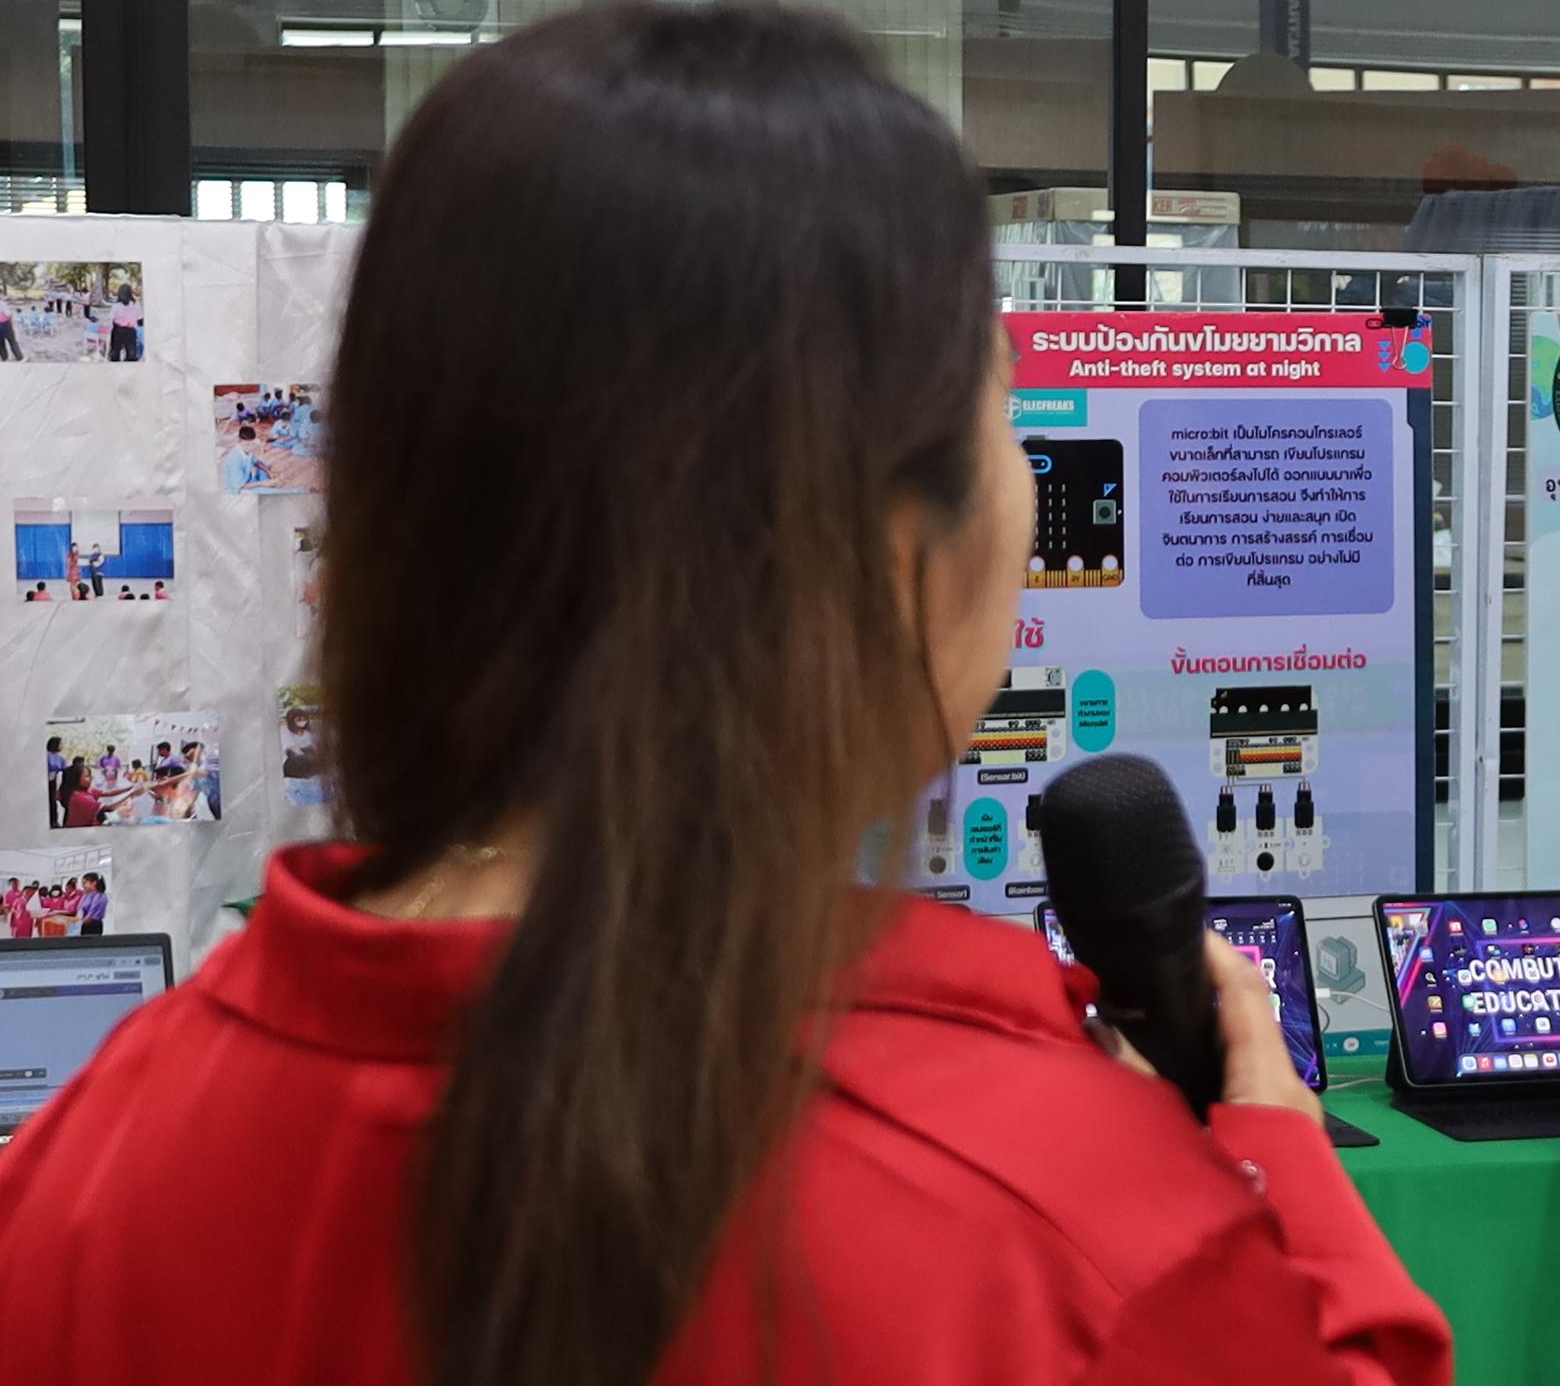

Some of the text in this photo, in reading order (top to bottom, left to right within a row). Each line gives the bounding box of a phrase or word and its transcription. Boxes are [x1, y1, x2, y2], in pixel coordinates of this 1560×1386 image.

[1032, 323, 1362, 353] ระบบป้องกันขโมยยามวิกาล
[1069, 358, 1321, 380] Anti-theft system at night
[1171, 425, 1363, 440] micro:bit เป็นไมโครคอนโทรเลอร์
[1169, 445, 1365, 461] ขนาดเล็กที่สามารถ เขียนโปรแกรม
[1284, 464, 1372, 481] ออกแบบมาเพื่อ
[1168, 488, 1366, 503] ใช้ในการเรียนการสอน จึงทำให้การ
[1180, 510, 1258, 524] เรียนการสอน
[1232, 531, 1317, 545] การสร้างสรรค์
[1321, 527, 1373, 544] การเชื่อม
[1176, 553, 1193, 566] ต่อ
[1198, 551, 1304, 566] การเขียนโปรแกรม
[1247, 570, 1291, 588] ที่สิ้นสุด
[1171, 644, 1367, 675] ขั้นตอนการเชื่อมต่อ
